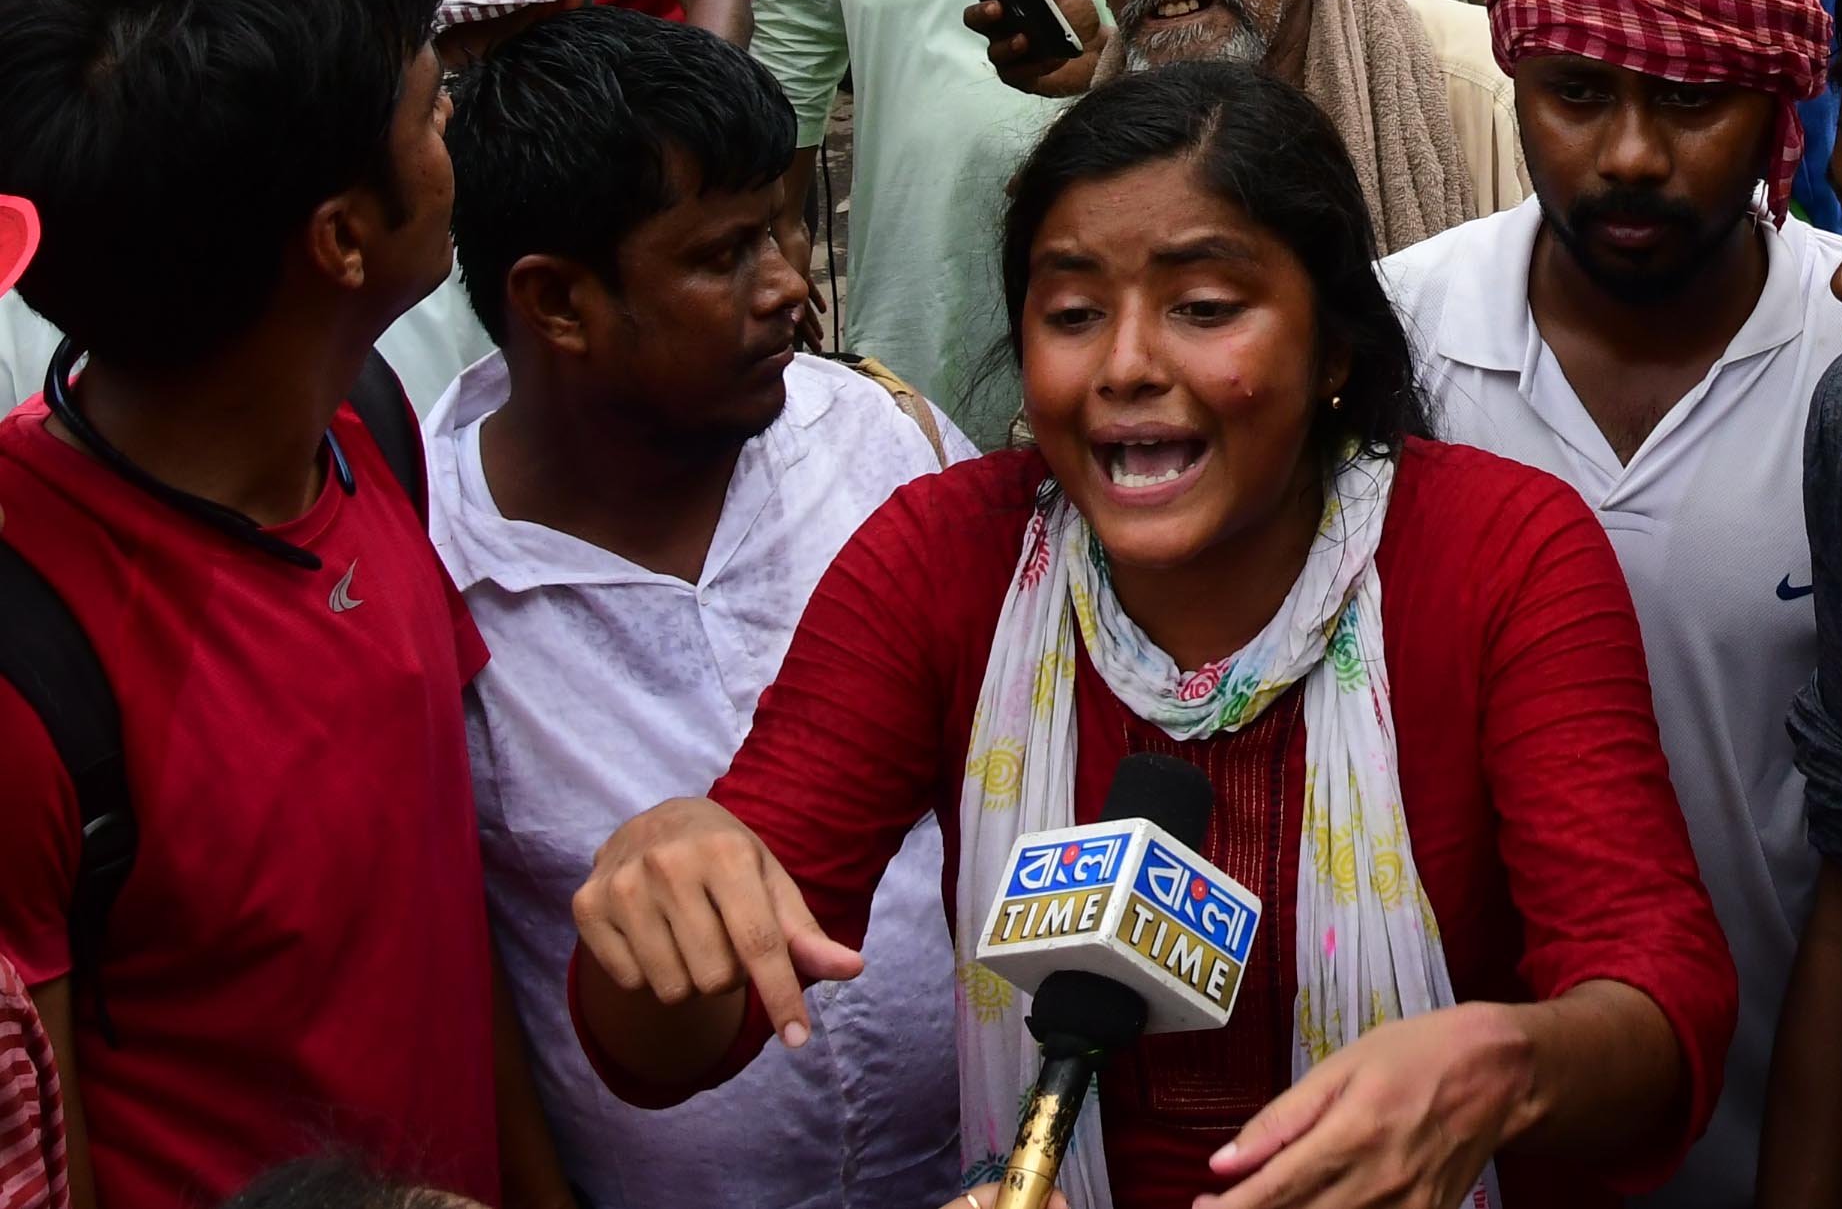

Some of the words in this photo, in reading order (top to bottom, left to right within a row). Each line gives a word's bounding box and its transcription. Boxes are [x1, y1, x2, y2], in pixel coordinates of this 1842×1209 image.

[1017, 836, 1123, 890] বাংলা
[1147, 847, 1248, 953] বাংলা
[1001, 893, 1103, 941] TIME
[1127, 904, 1230, 1002] TIME
